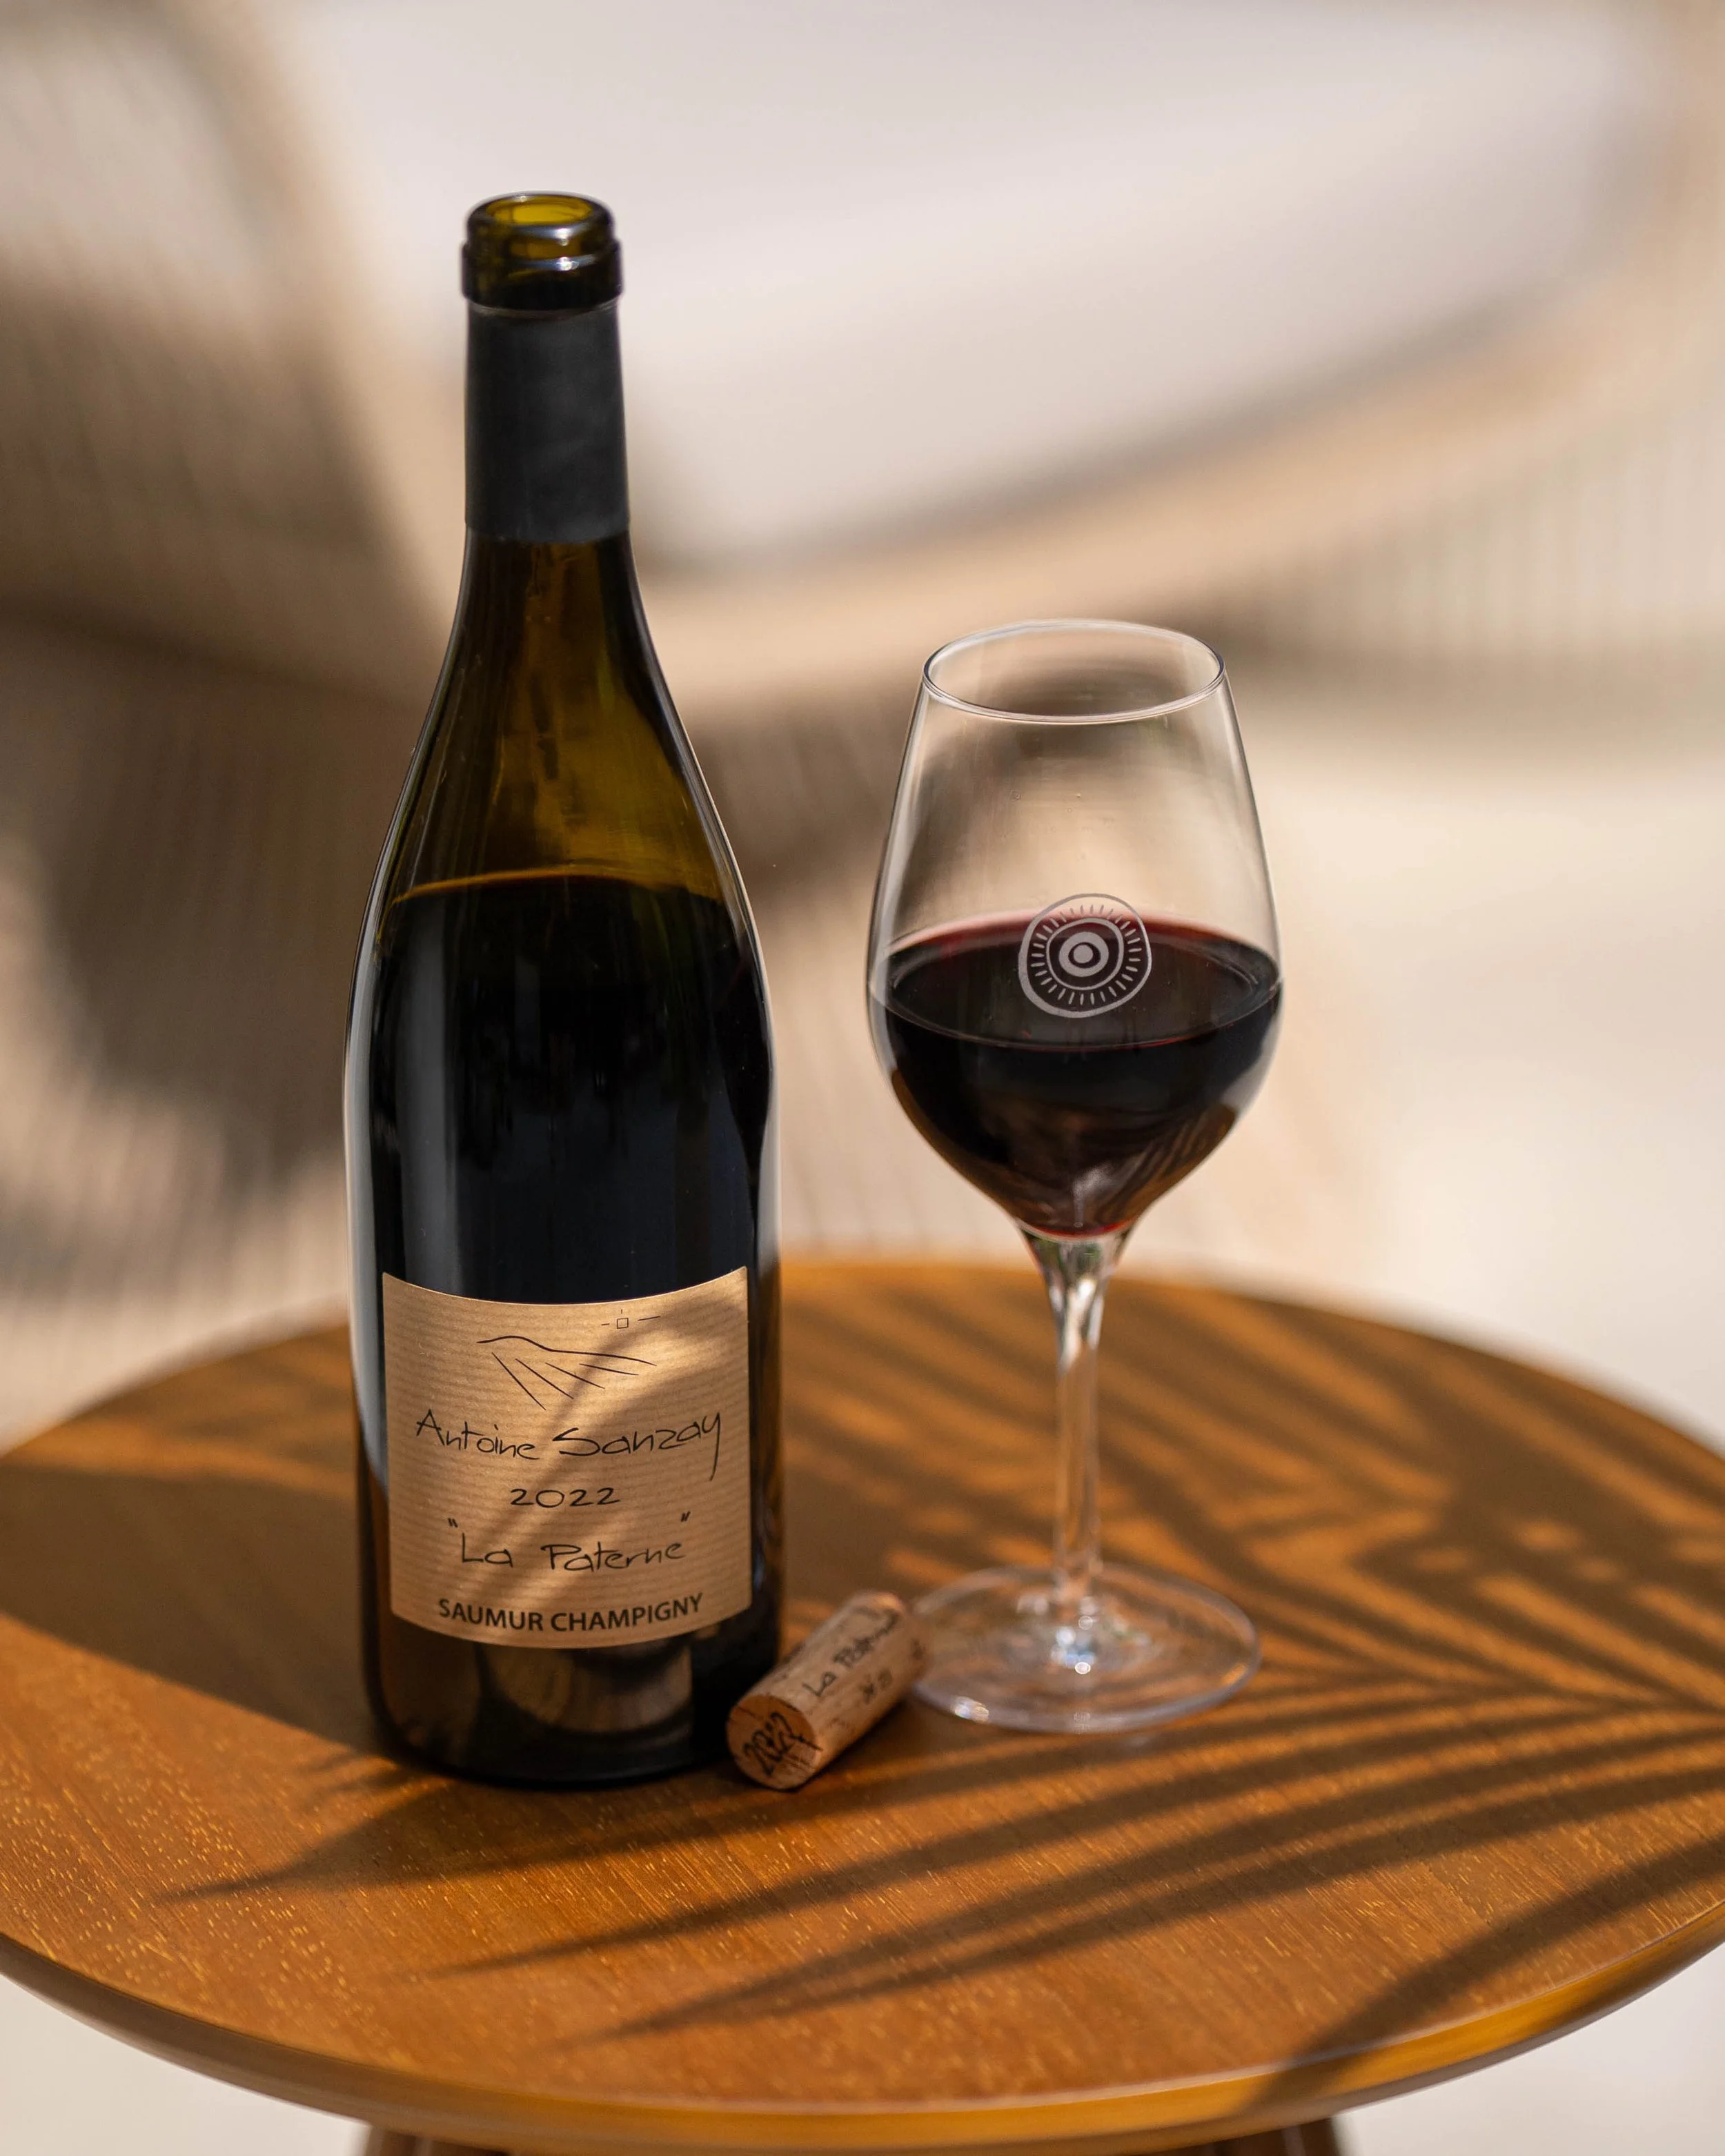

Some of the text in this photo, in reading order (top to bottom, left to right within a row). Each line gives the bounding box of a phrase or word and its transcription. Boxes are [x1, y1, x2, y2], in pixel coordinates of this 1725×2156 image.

[416, 1408, 721, 1482] Antoine Sanzay
[510, 1487, 620, 1508] 2022
[438, 1592, 704, 1632] SAUMUR CHAMPIGNY
